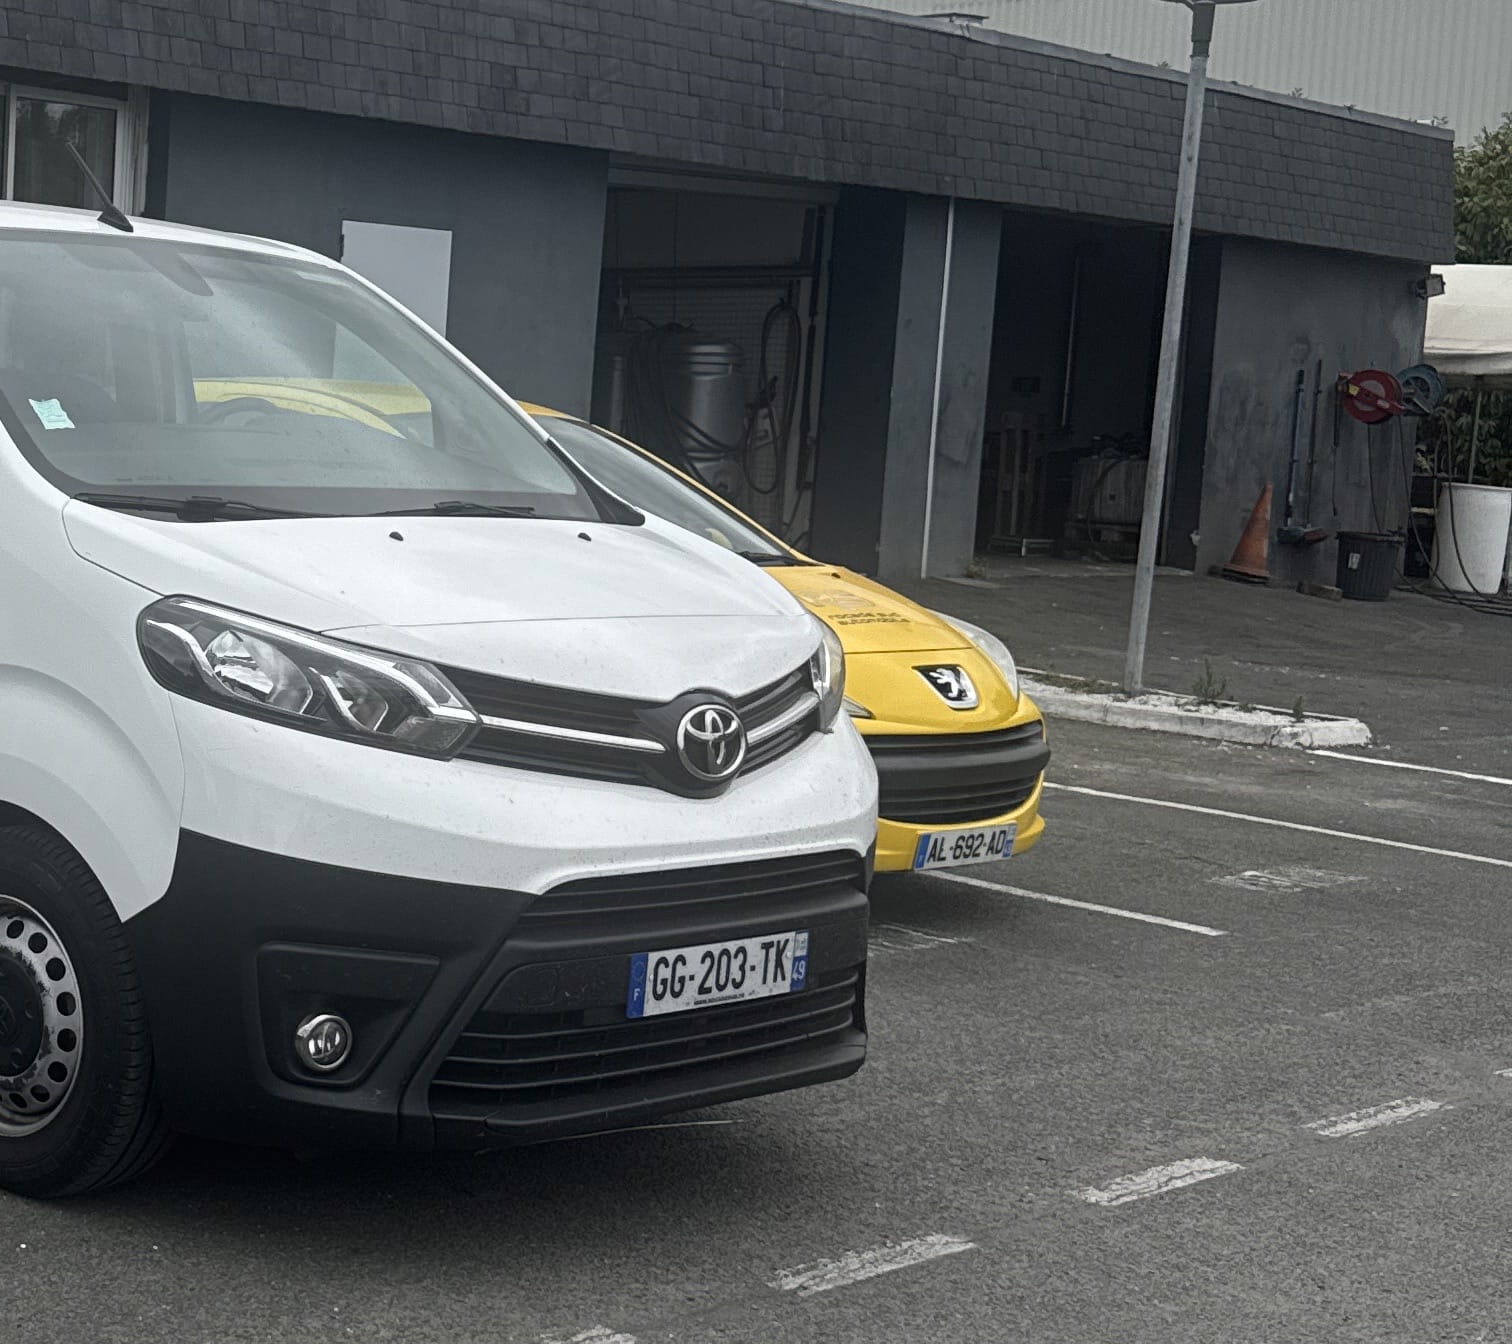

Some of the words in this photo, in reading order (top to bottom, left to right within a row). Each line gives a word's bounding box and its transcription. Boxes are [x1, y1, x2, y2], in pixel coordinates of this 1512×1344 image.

[652, 938, 790, 1001] GG-203-TK
[792, 960, 806, 982] 49
[633, 987, 641, 1001] F
